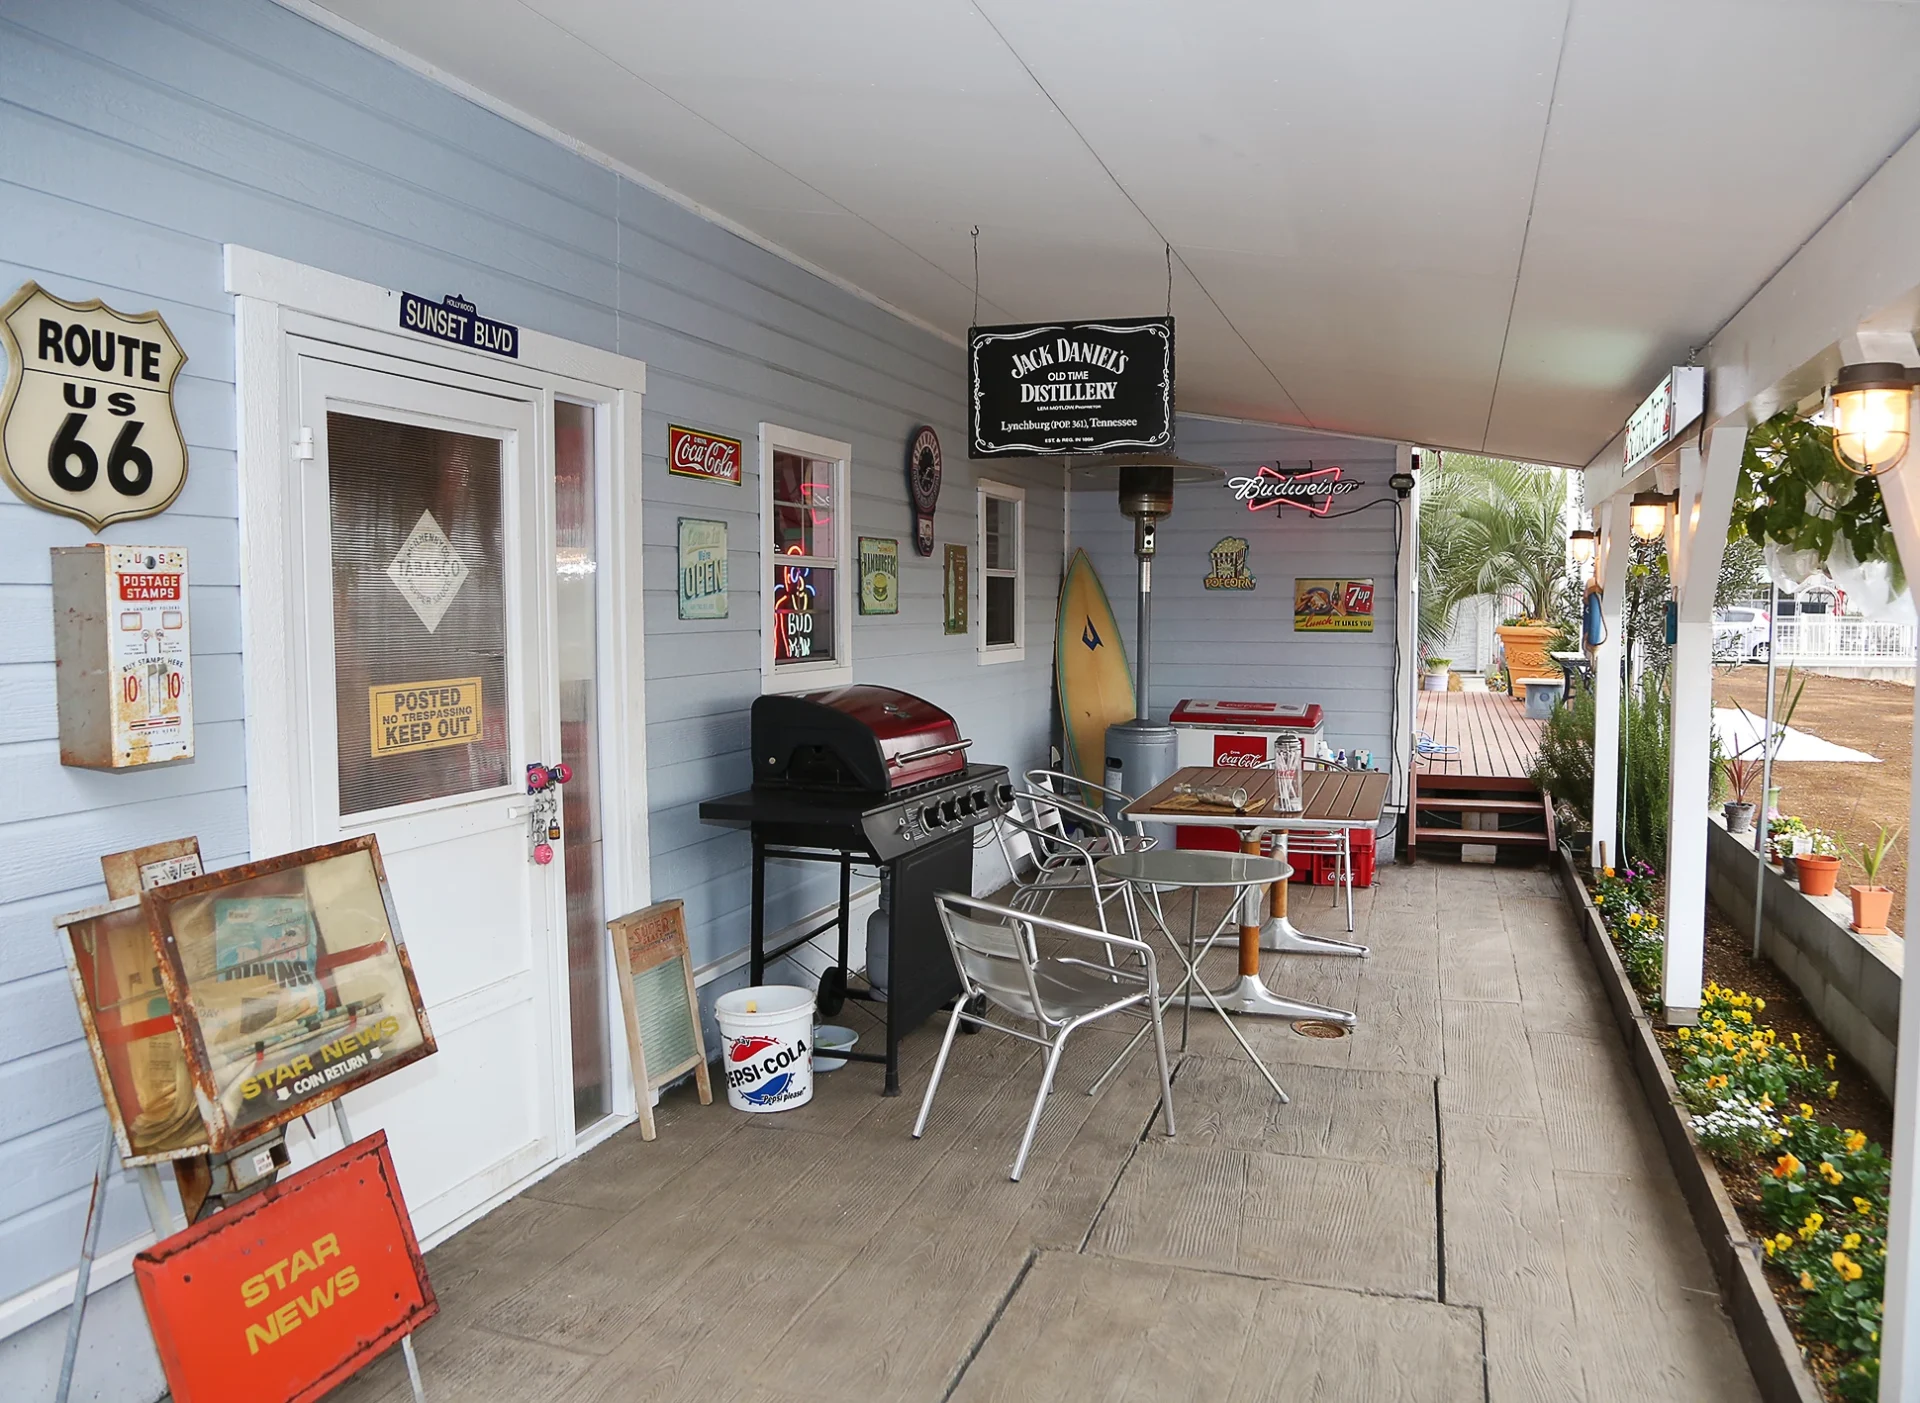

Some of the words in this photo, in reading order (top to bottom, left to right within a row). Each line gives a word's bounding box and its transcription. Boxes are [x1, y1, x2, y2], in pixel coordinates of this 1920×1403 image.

[446, 298, 475, 313] HOLLYWOOD
[406, 299, 468, 341] SUNSET
[474, 320, 514, 353] BLVD
[38, 317, 161, 383] ROUTE
[1011, 343, 1055, 379] JACK
[1056, 337, 1129, 375] DANIEL'S
[1047, 371, 1066, 381] OLD
[1067, 370, 1089, 381] TIME
[1020, 381, 1118, 403] DISTILLERY
[1001, 420, 1050, 433] Lynchburg
[1089, 417, 1138, 428] Tennessee
[47, 412, 153, 497] 66
[674, 433, 736, 477] Coca-Cola
[1227, 475, 1360, 501] Budweiser
[397, 559, 461, 578] TABASCO
[684, 559, 723, 601] OPEN
[122, 575, 178, 588] POSTAGE
[126, 588, 175, 599] STAMPS
[788, 612, 813, 636] BUD
[1359, 619, 1372, 627] YOU
[122, 662, 137, 673] BUY
[137, 656, 165, 667] STAMPS
[167, 657, 184, 668] HERE
[394, 687, 461, 712] POSTED
[382, 714, 399, 725] NO
[401, 705, 473, 722] TRESPASSING
[385, 721, 432, 746] KEEP
[437, 716, 470, 738] OUT
[240, 1053, 314, 1100] STAR
[320, 1015, 400, 1063] NEWS
[293, 1071, 326, 1094] COIN
[324, 1054, 369, 1081] RETURN
[240, 1232, 341, 1309] STAR
[244, 1265, 360, 1356] NEWS
